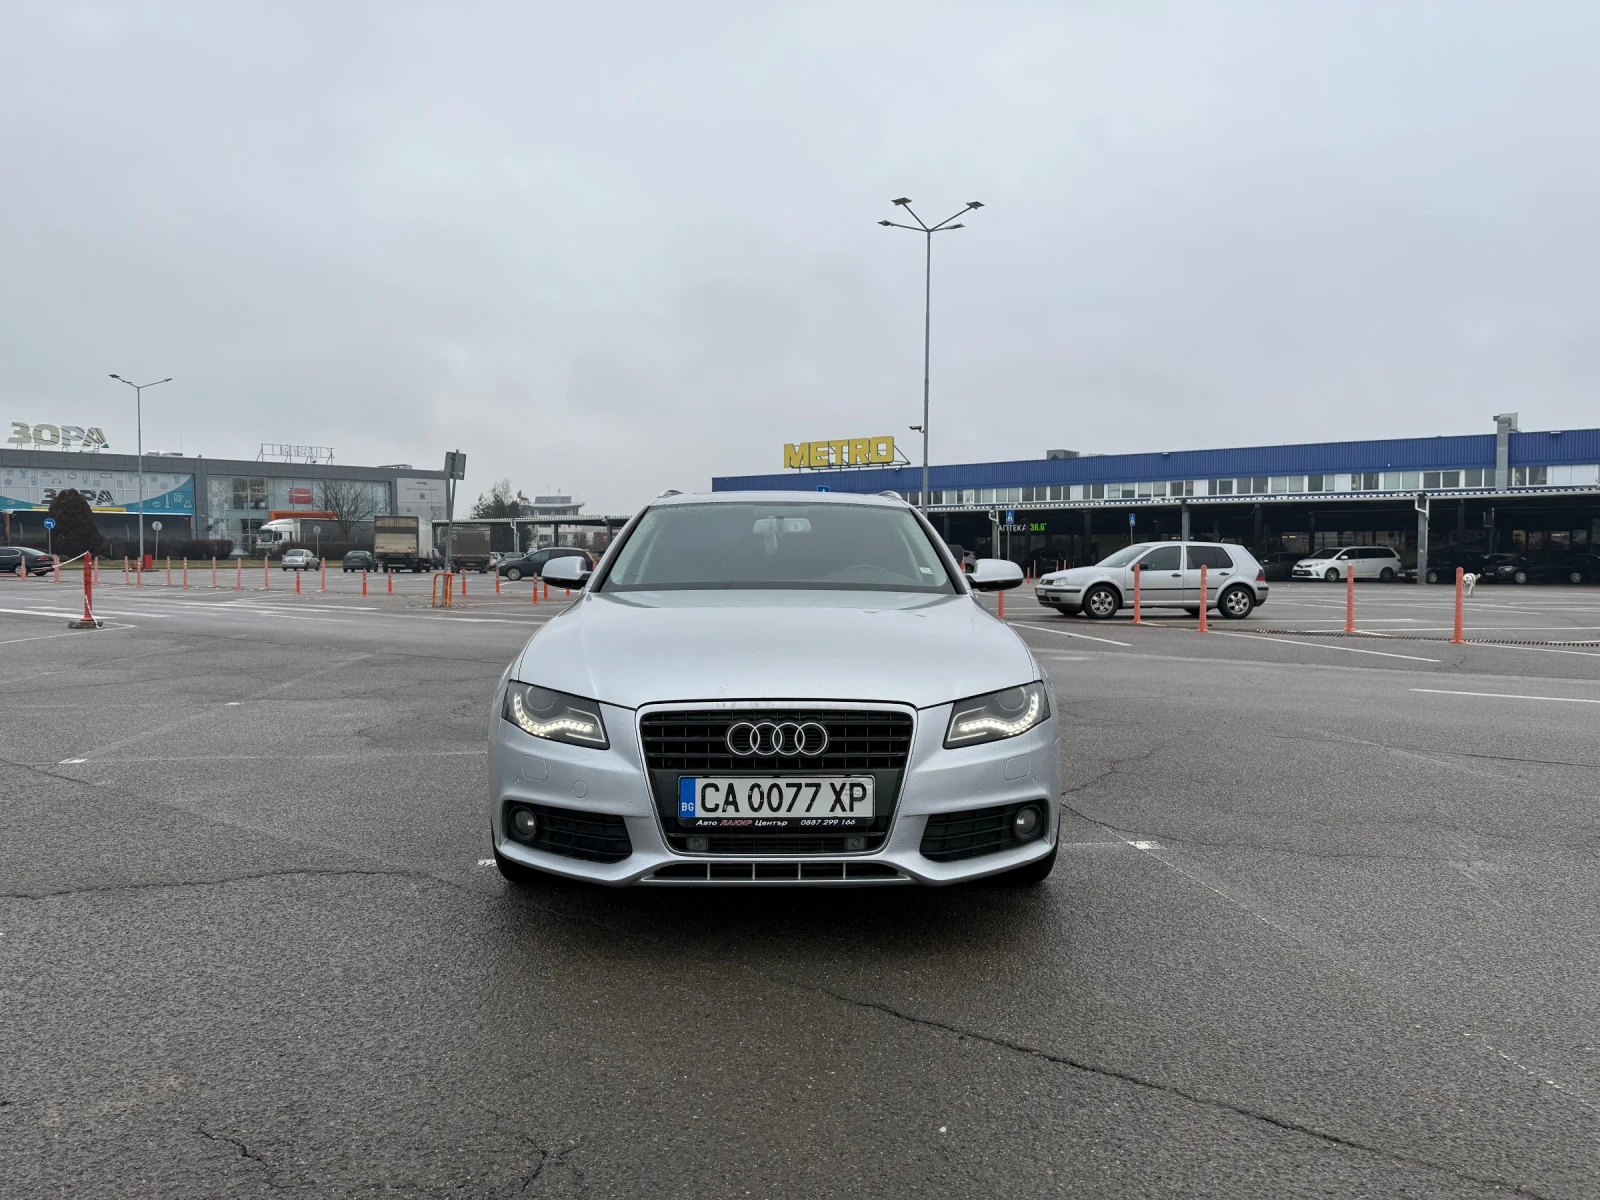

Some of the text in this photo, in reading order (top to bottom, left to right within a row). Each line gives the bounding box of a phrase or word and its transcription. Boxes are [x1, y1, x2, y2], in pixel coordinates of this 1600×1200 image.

[7, 421, 109, 448] ЗОРА
[784, 436, 895, 468] METRO
[41, 488, 115, 506] ЗРА
[681, 802, 694, 812] BG
[701, 782, 867, 813] CA 0077 XP
[696, 819, 718, 827] Авто
[755, 819, 788, 828] Център
[800, 818, 821, 826] 0887
[822, 818, 841, 826] 299
[841, 818, 856, 826] 166
